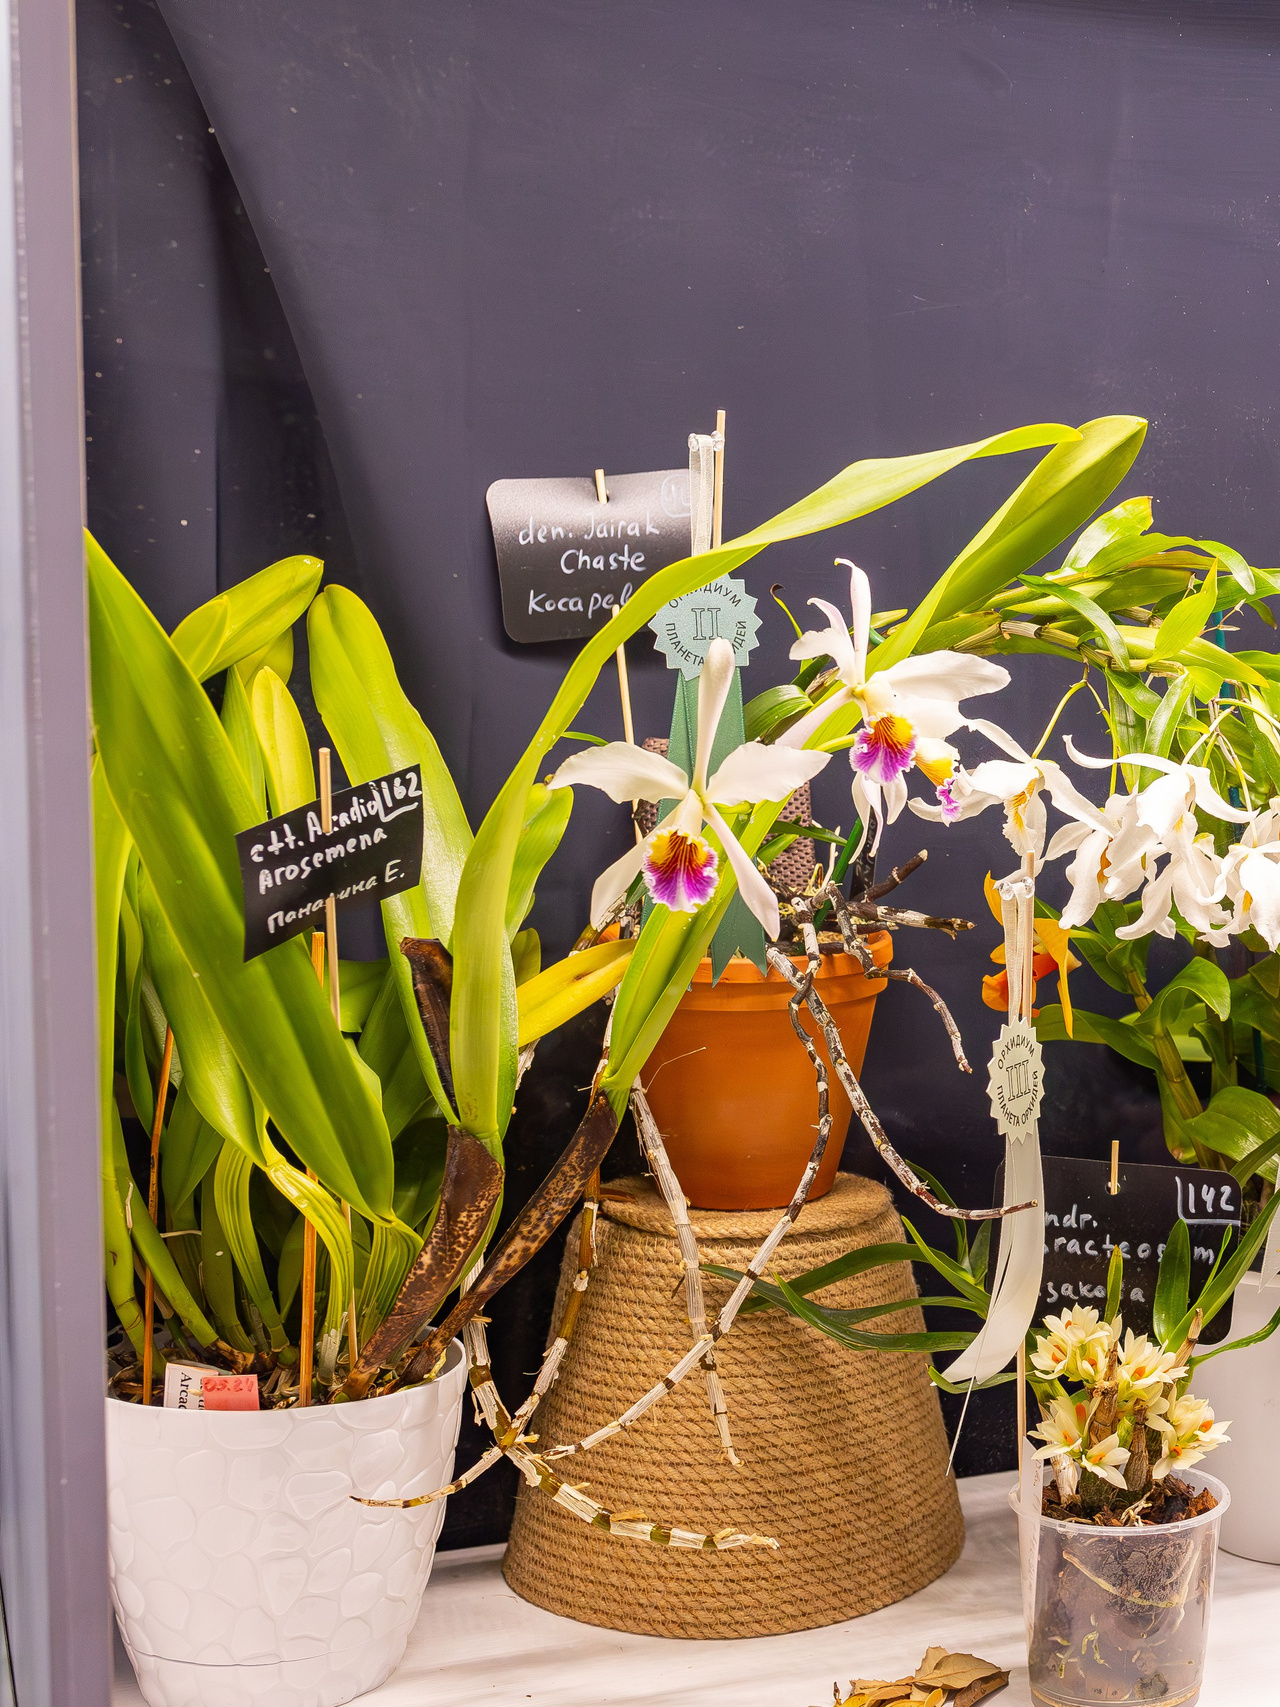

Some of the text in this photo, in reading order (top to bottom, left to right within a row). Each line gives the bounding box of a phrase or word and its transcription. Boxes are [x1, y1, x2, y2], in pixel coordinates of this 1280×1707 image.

[519, 510, 660, 545] den. Jairak
[560, 544, 647, 575] Chaste
[668, 582, 742, 609] ОДИУМ
[665, 620, 747, 667] ПЛАНЕТА ИДЕЙ
[306, 796, 380, 842] Aadio
[258, 827, 388, 895] Arosemena
[384, 859, 405, 883] Е.
[997, 1034, 1035, 1070] ОРХИДИУМ
[996, 1070, 1039, 1127] ПЛАНЕТА ОРХИДЕЙ
[1006, 1060, 1031, 1102] III
[1188, 1183, 1235, 1214] 142
[1044, 1203, 1098, 1230] ndr.
[1044, 1234, 1215, 1265] racteosm
